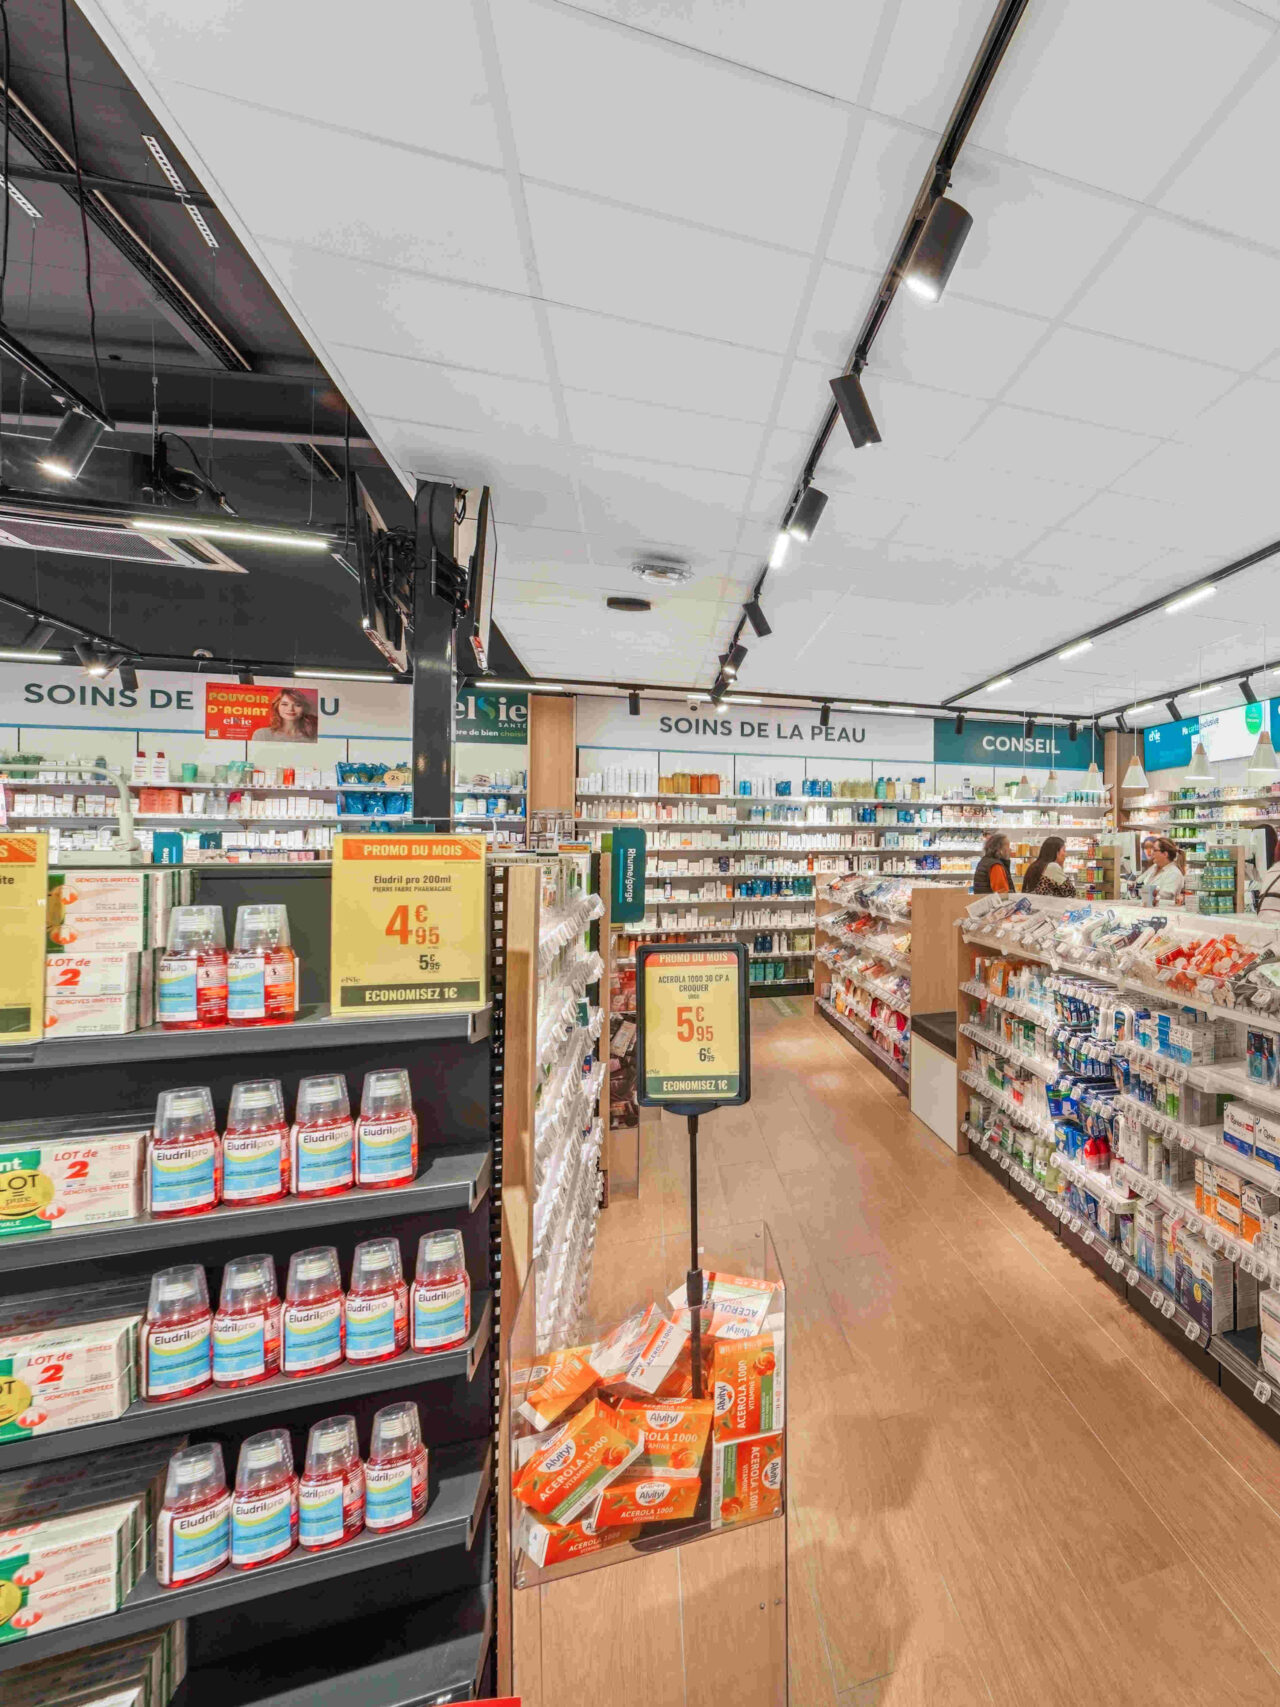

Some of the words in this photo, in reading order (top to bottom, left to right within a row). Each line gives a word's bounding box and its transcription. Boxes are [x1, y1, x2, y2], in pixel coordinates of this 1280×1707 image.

[24, 683, 138, 707] SOINS
[151, 689, 194, 710] DE
[208, 692, 269, 704] POUVOIR
[207, 705, 269, 716] D'ACHAT
[659, 716, 733, 736] SOINS
[740, 721, 770, 739] DE
[777, 723, 806, 740] LA
[811, 725, 867, 744] PEAU
[982, 735, 1061, 755] CONSEIL
[363, 845, 409, 856] PROMO
[412, 845, 428, 856] DU
[432, 844, 463, 855] MOIS
[374, 876, 403, 884] Eludril
[405, 877, 420, 885] pro
[423, 875, 452, 884] 200ml
[625, 848, 636, 902] Rhume/gorge
[75, 958, 91, 966] de
[660, 953, 690, 963] PROMO
[692, 953, 704, 962] DU
[707, 952, 728, 961] MOIS
[55, 969, 81, 986] 2
[658, 975, 687, 984] ACEROLA
[365, 988, 441, 1002] ECONOMISEZ
[443, 987, 458, 999] 1€
[679, 984, 709, 992] CROQUER
[663, 1080, 715, 1092] ECONOMISEZ
[48, 1151, 79, 1162] LOT
[82, 1150, 98, 1158] de
[64, 1161, 89, 1179] 2
[0, 1174, 39, 1193] OT
[27, 1354, 54, 1367] LOT
[56, 1352, 74, 1362] de
[37, 1364, 64, 1385] 2
[737, 1384, 747, 1429] ACEROLA
[650, 1412, 680, 1423] Alvityl
[673, 1433, 698, 1442] 1000
[545, 1444, 573, 1470] Alvityl
[539, 1459, 585, 1501] ACEROLA
[583, 1435, 609, 1459] 1000
[750, 1446, 760, 1488] ACEROLA
[640, 1490, 666, 1500] Alvityl
[620, 1508, 655, 1518] ACEROLA
[569, 1537, 601, 1551] ACEROLA
